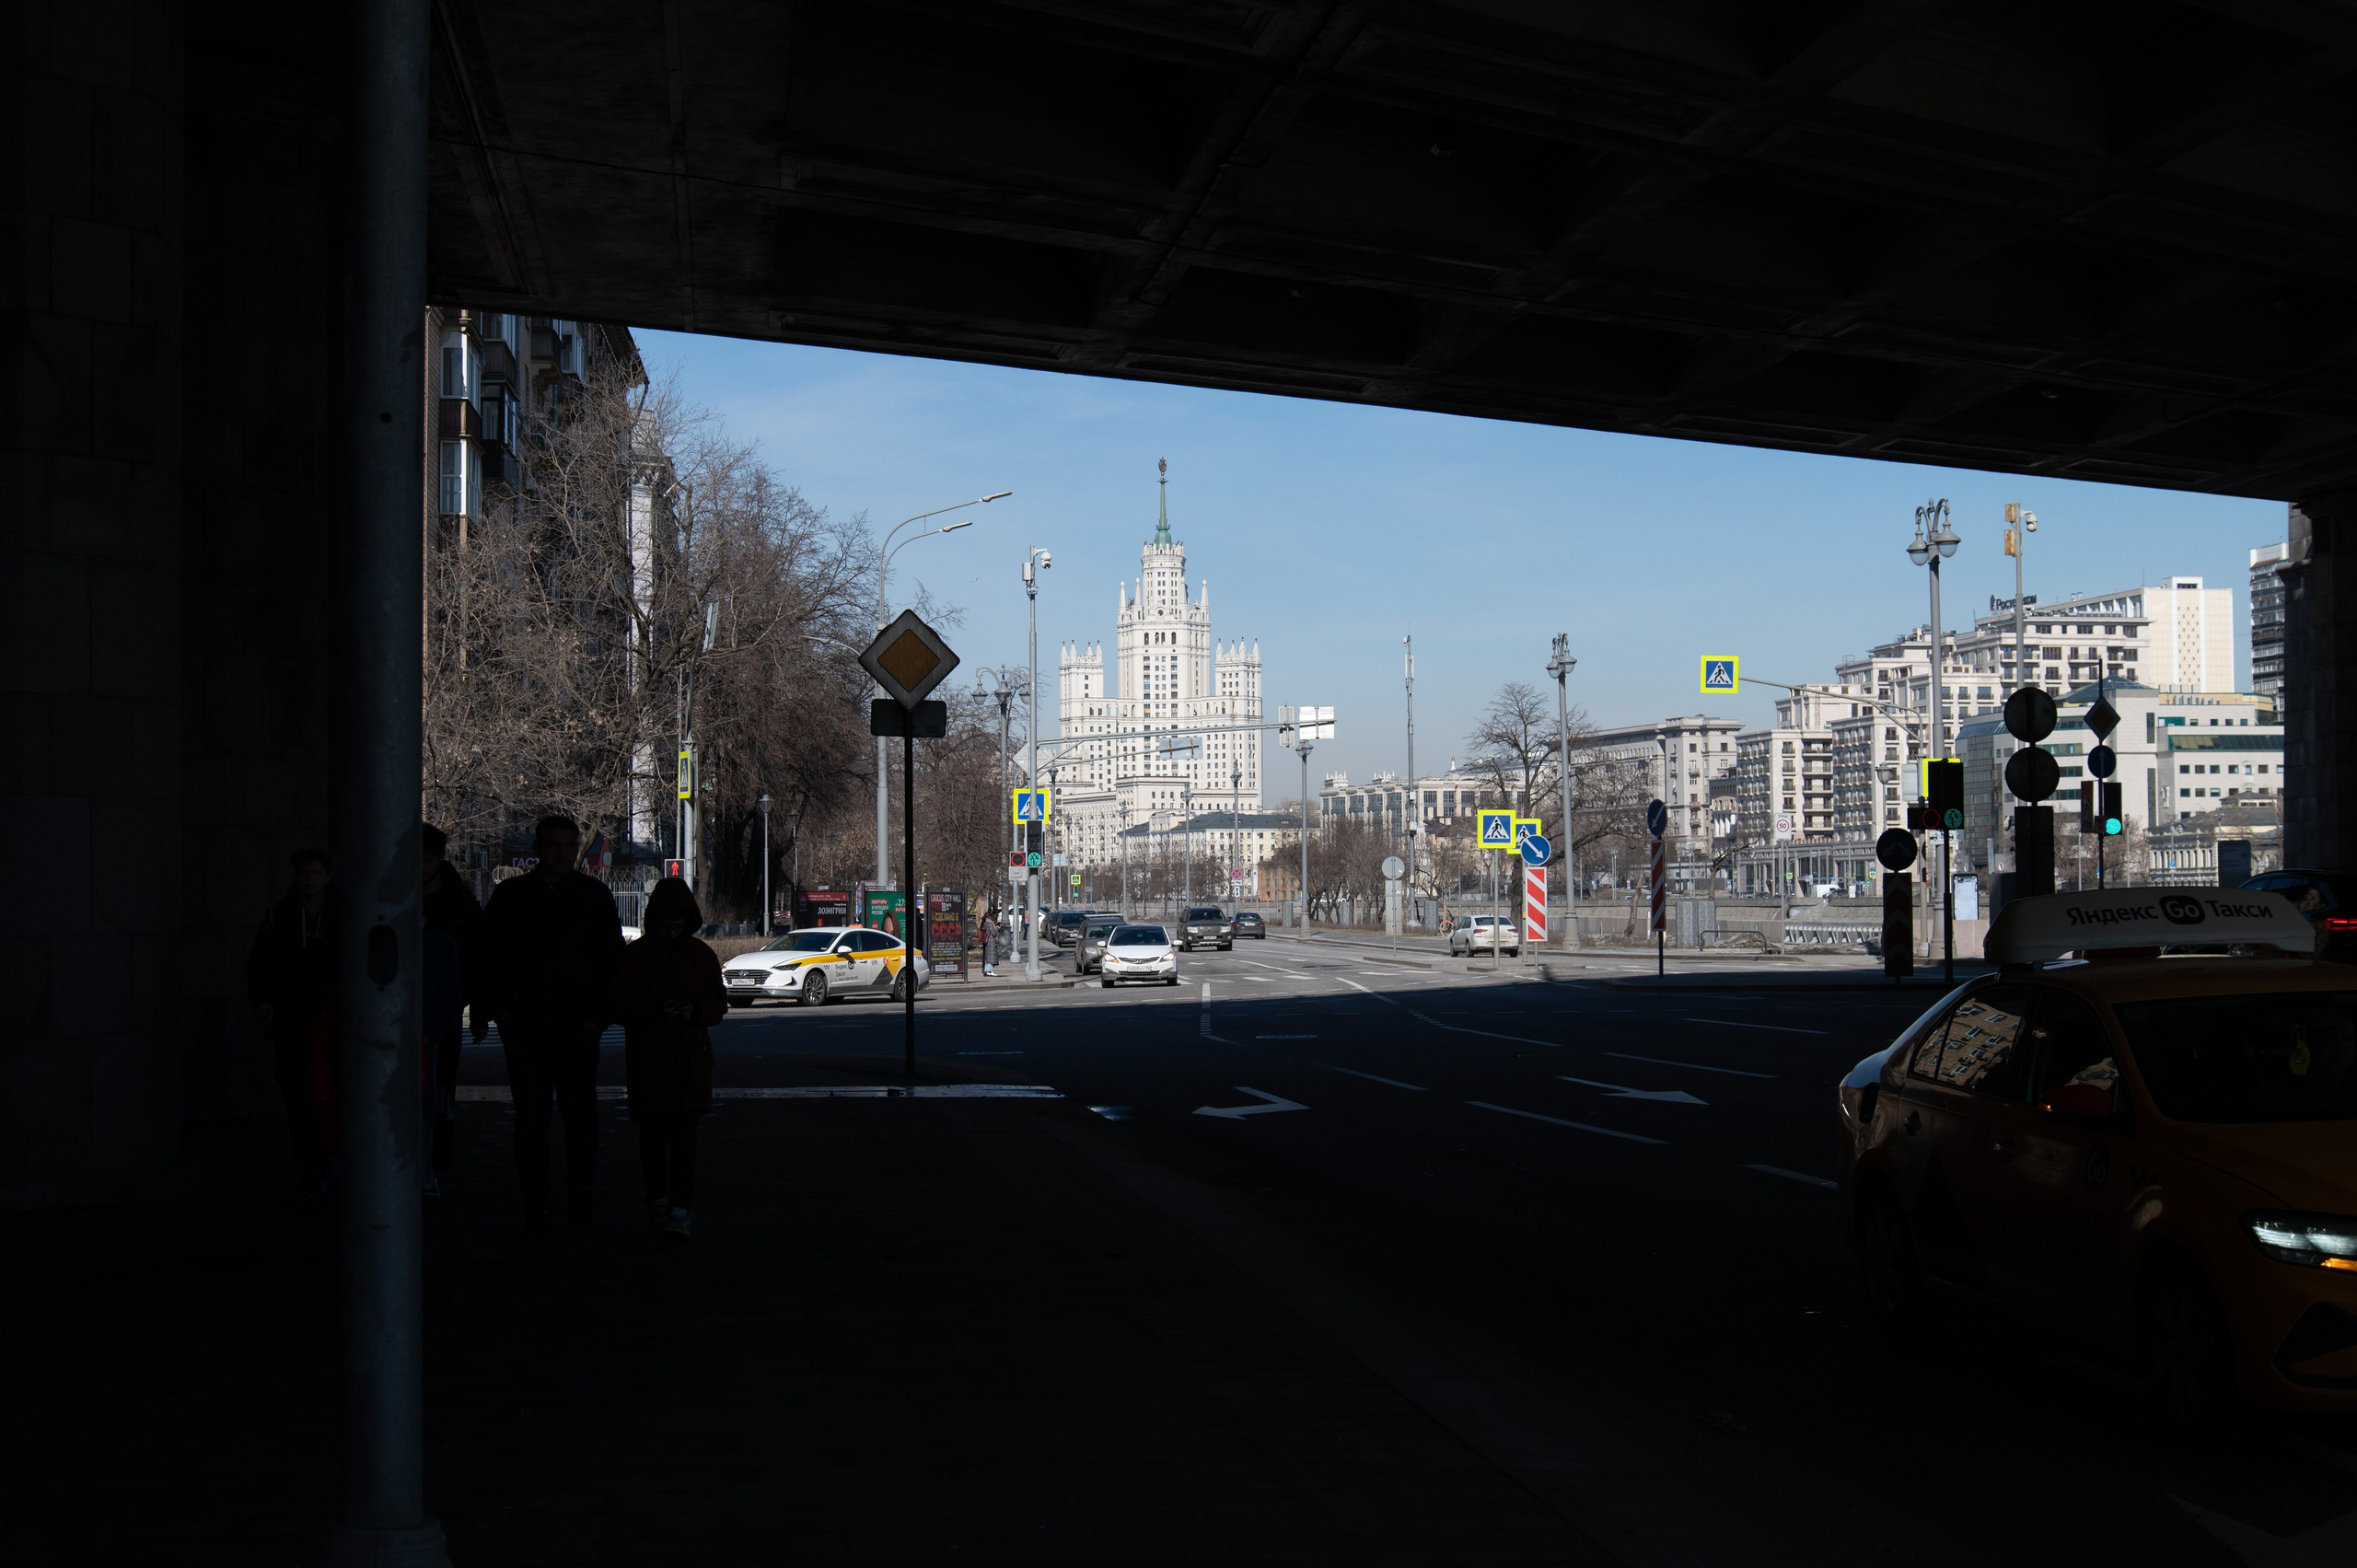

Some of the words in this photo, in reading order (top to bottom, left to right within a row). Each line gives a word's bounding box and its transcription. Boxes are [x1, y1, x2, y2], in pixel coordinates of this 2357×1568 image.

[1996, 595, 2038, 610] Ростеком
[930, 894, 945, 902] CROCUS
[817, 907, 847, 915] ЛОЭНГРИН
[935, 912, 955, 922] СДЕЛАНО
[2065, 905, 2158, 925] Яндекс
[2165, 900, 2200, 919] Go
[2204, 900, 2273, 918] Такси
[931, 922, 962, 940] СССР
